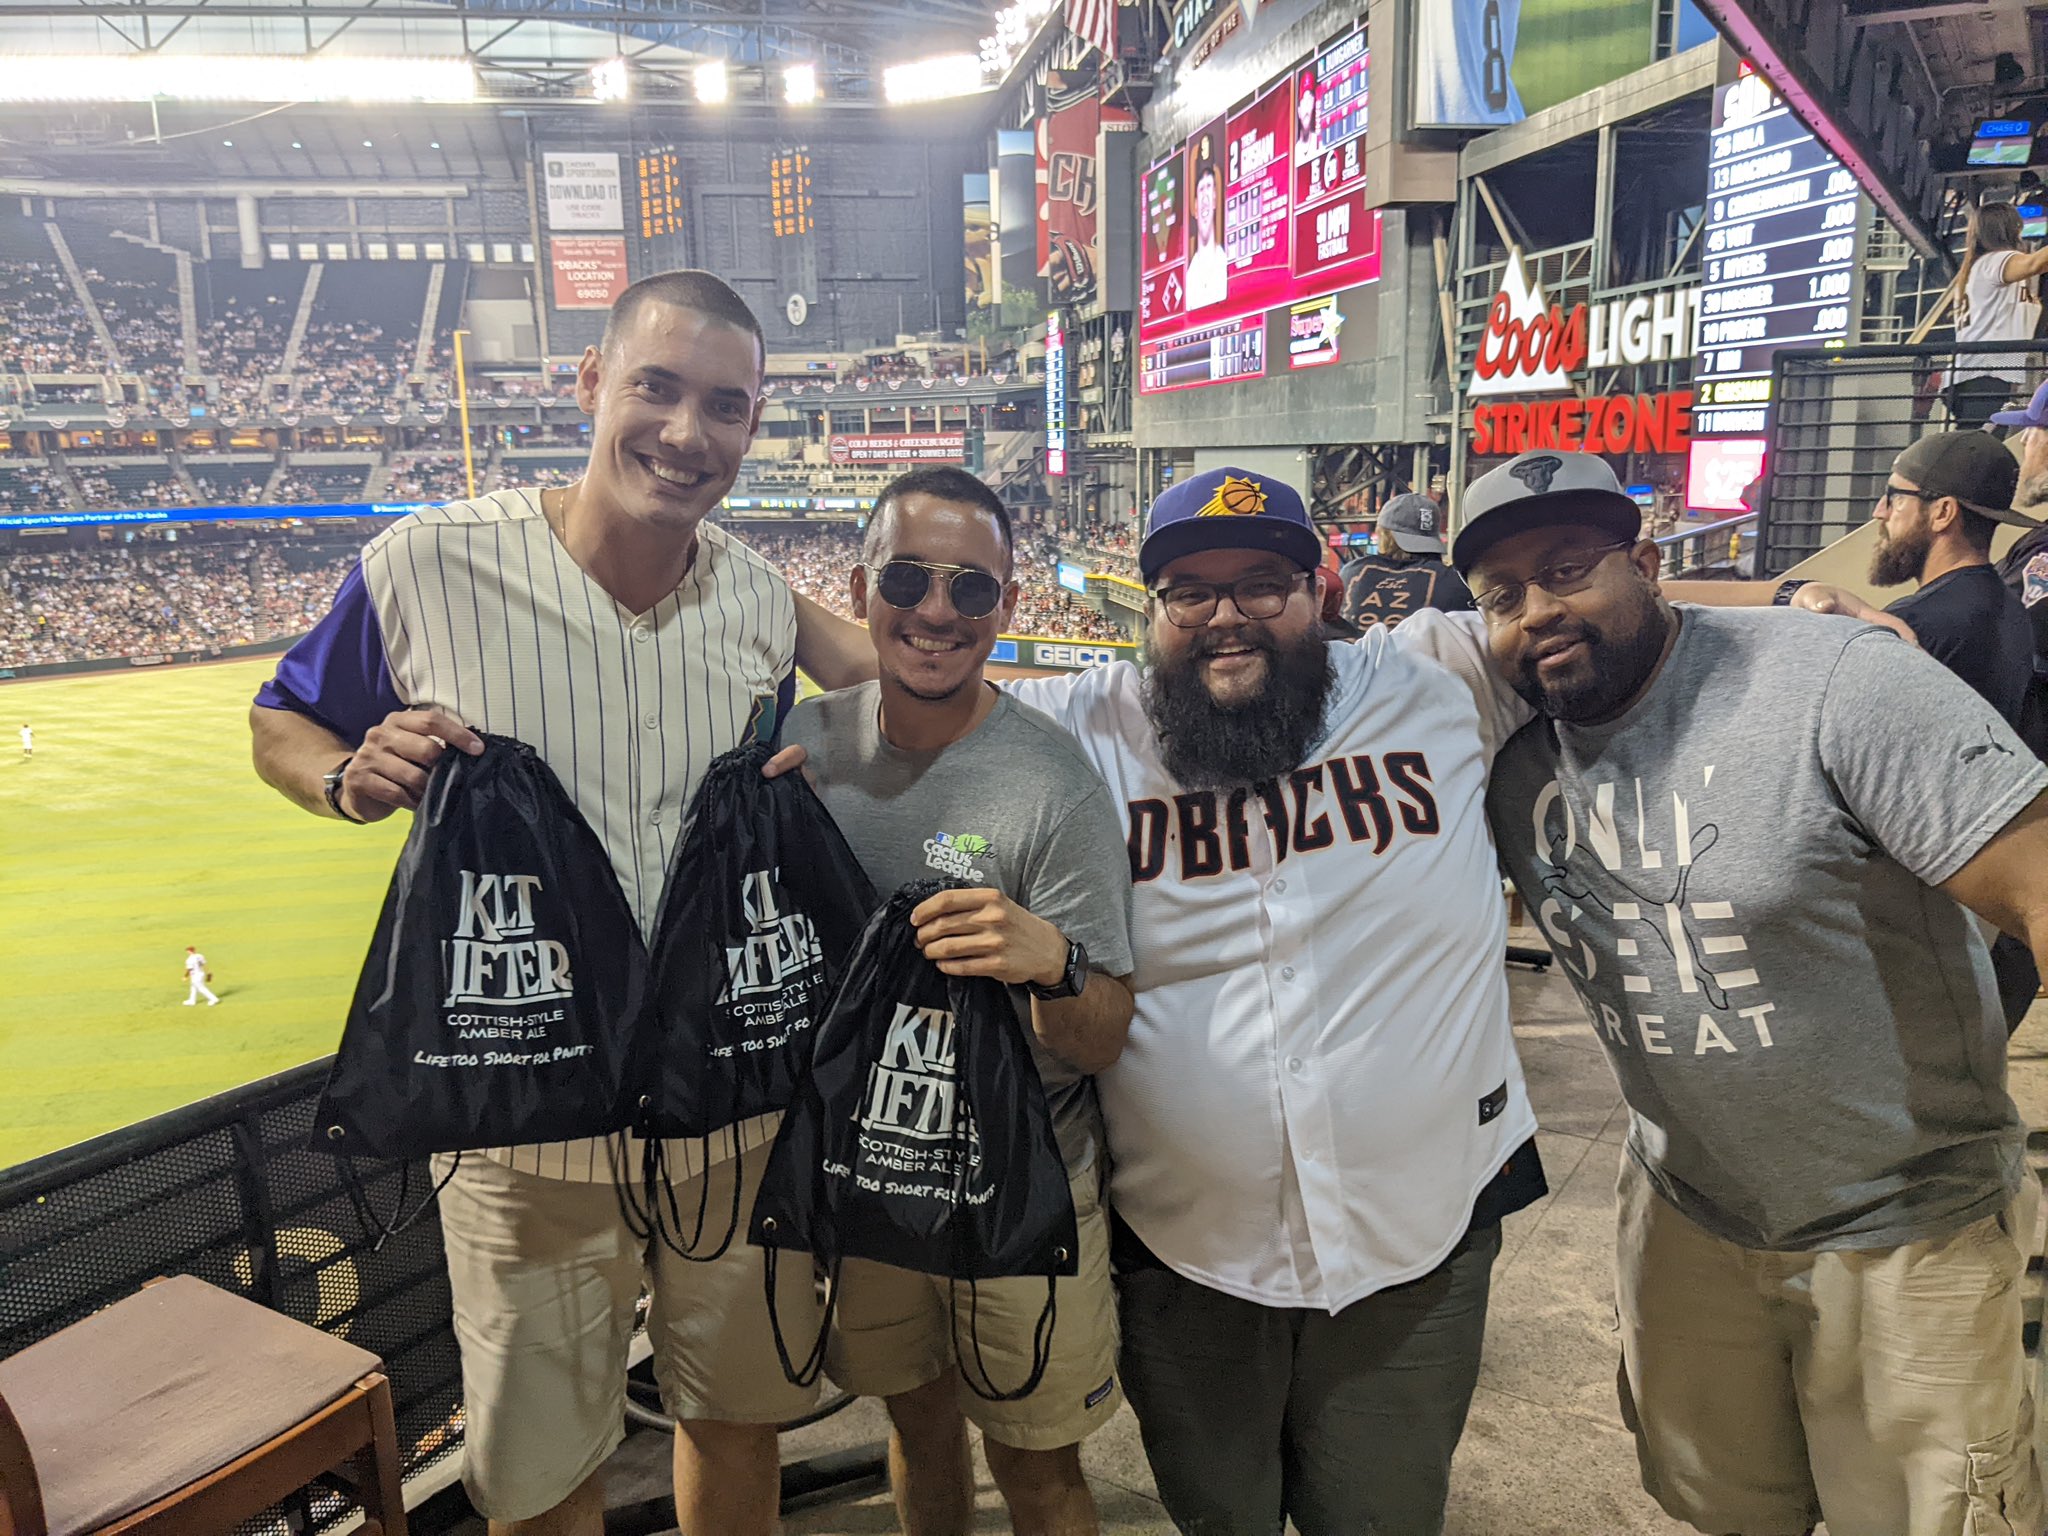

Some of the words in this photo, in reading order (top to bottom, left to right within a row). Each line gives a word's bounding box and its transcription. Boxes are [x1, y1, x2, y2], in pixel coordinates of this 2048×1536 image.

[549, 184, 606, 200] DOWNLOAD
[567, 271, 615, 281] LOCATION
[1474, 290, 1587, 381] Coors
[1587, 288, 1702, 370] LIGHT
[23, 515, 50, 526] Sports
[50, 513, 84, 523] Medicine
[85, 512, 113, 522] Partner
[1036, 646, 1113, 669] GEICO
[923, 838, 974, 868] Cactus
[925, 851, 984, 883] League
[447, 1009, 565, 1028] COTTISH-STYLE
[744, 1010, 786, 1028] AMBE
[459, 1027, 523, 1040] AMBER
[526, 1026, 547, 1040] ALE
[878, 1002, 956, 1074] KIL
[711, 1046, 734, 1058] IFE
[741, 1039, 765, 1053] TOO
[413, 1050, 451, 1068] LIFE
[450, 1054, 479, 1067] TOO
[483, 1051, 533, 1066] SHORT
[532, 1052, 551, 1066] FOR
[865, 1152, 927, 1172] AMBER
[855, 1174, 881, 1192] TOO
[885, 1181, 935, 1198] SHORT
